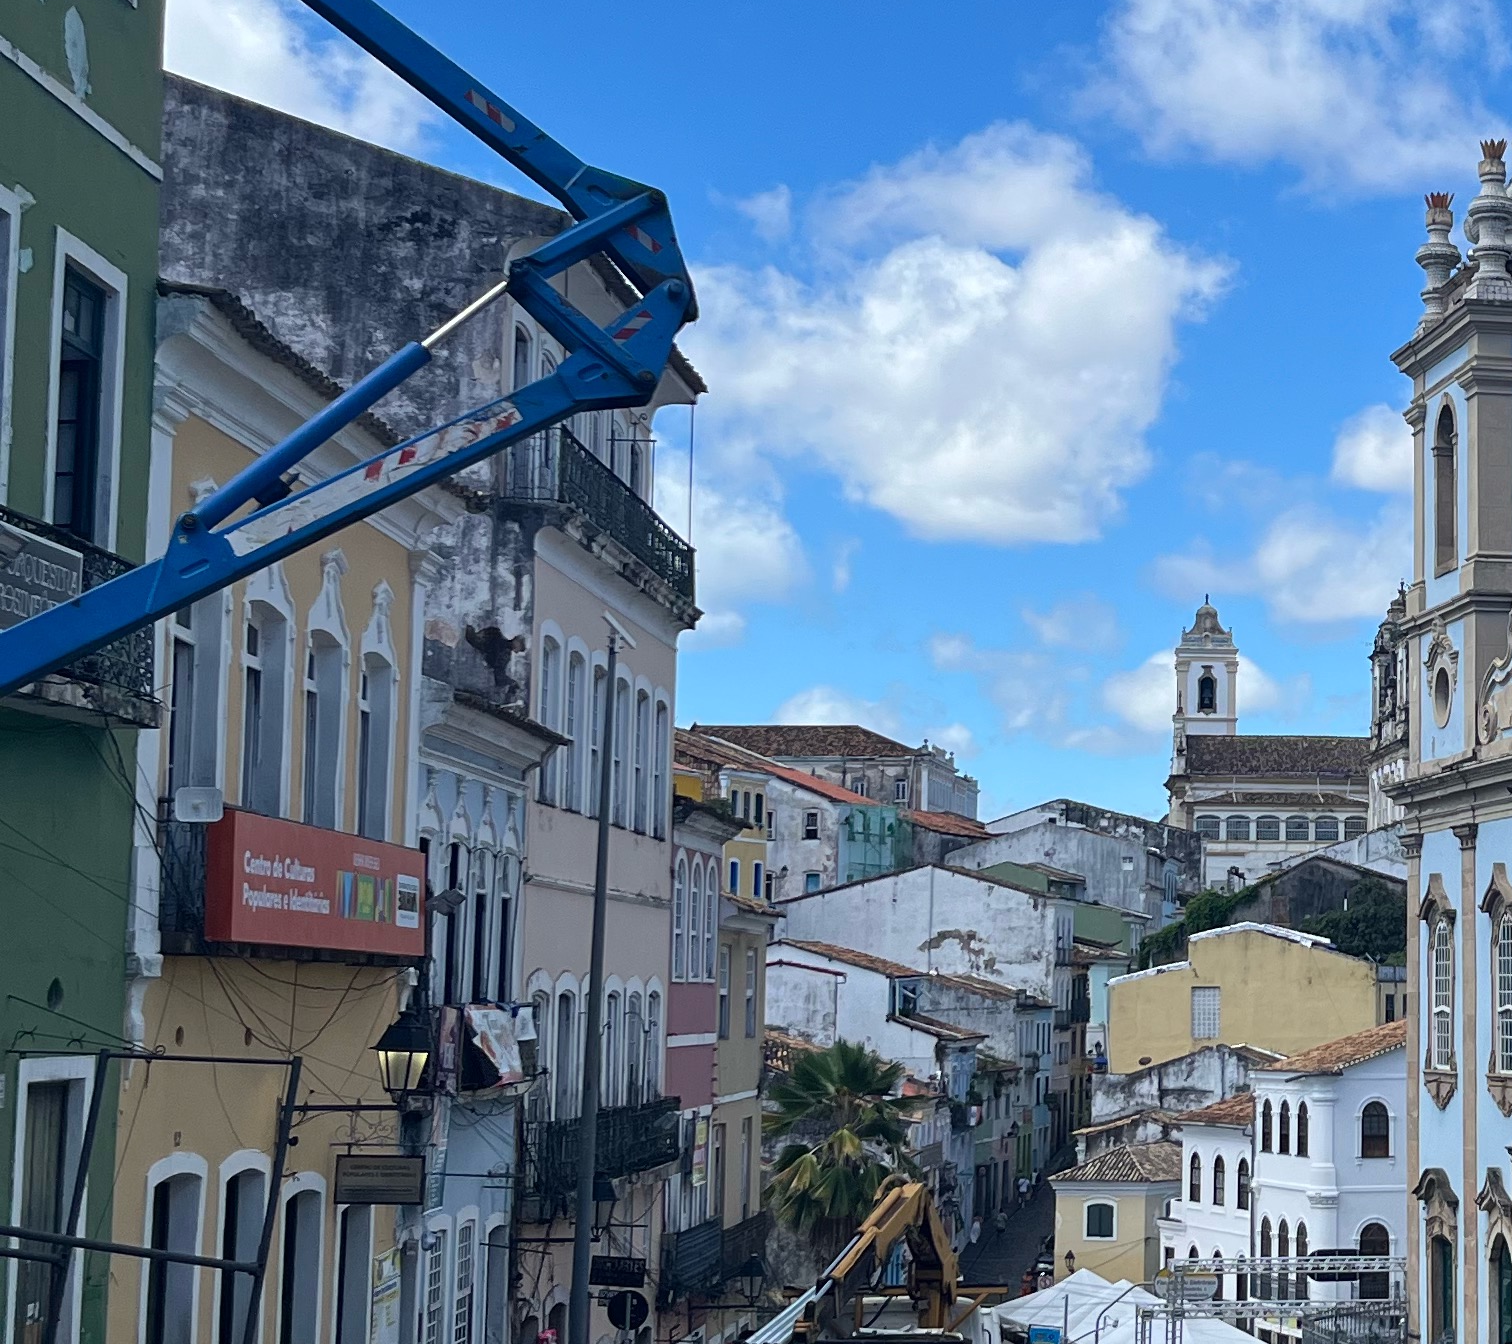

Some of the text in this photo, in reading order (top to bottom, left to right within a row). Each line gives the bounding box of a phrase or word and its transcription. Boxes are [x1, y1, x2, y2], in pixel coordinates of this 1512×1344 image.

[244, 851, 271, 877] Centro
[273, 855, 283, 878] de
[242, 882, 282, 912] Populares
